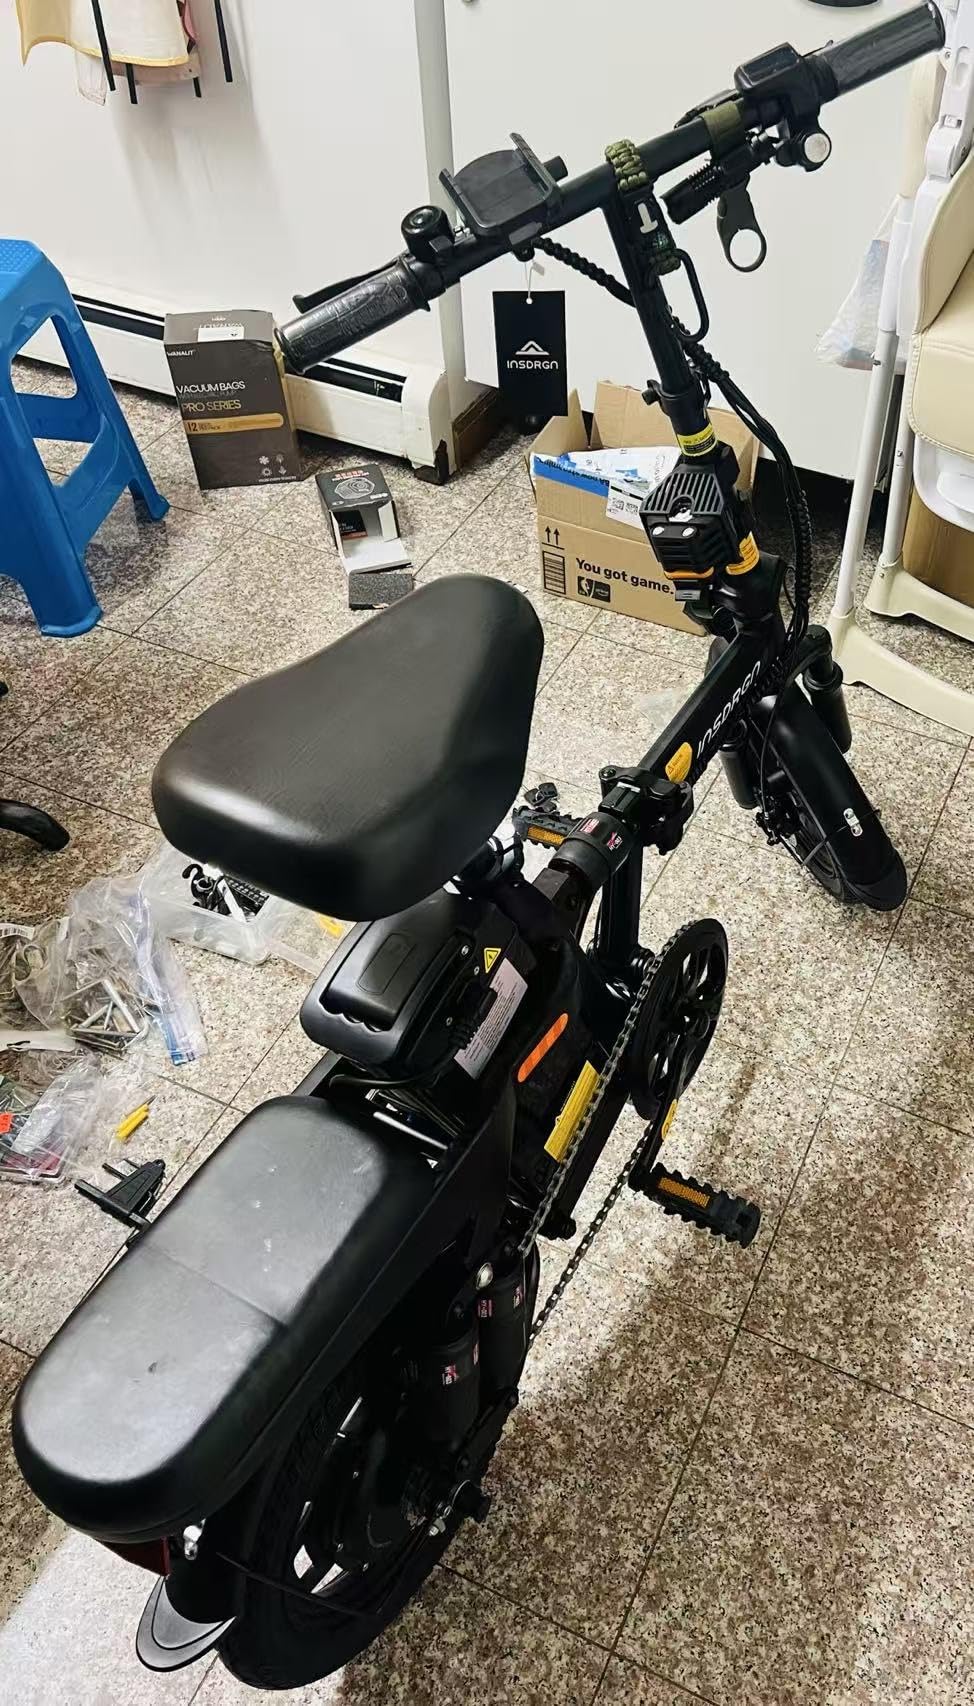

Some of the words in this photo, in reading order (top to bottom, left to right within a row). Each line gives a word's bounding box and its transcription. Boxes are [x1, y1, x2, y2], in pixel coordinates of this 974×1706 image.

[176, 383, 219, 394] VACUUM
[220, 381, 246, 391] BAGS
[182, 402, 206, 413] PRO
[207, 400, 242, 411] SERIES
[576, 557, 601, 575] You
[603, 567, 628, 583] got
[630, 575, 675, 595] game.
